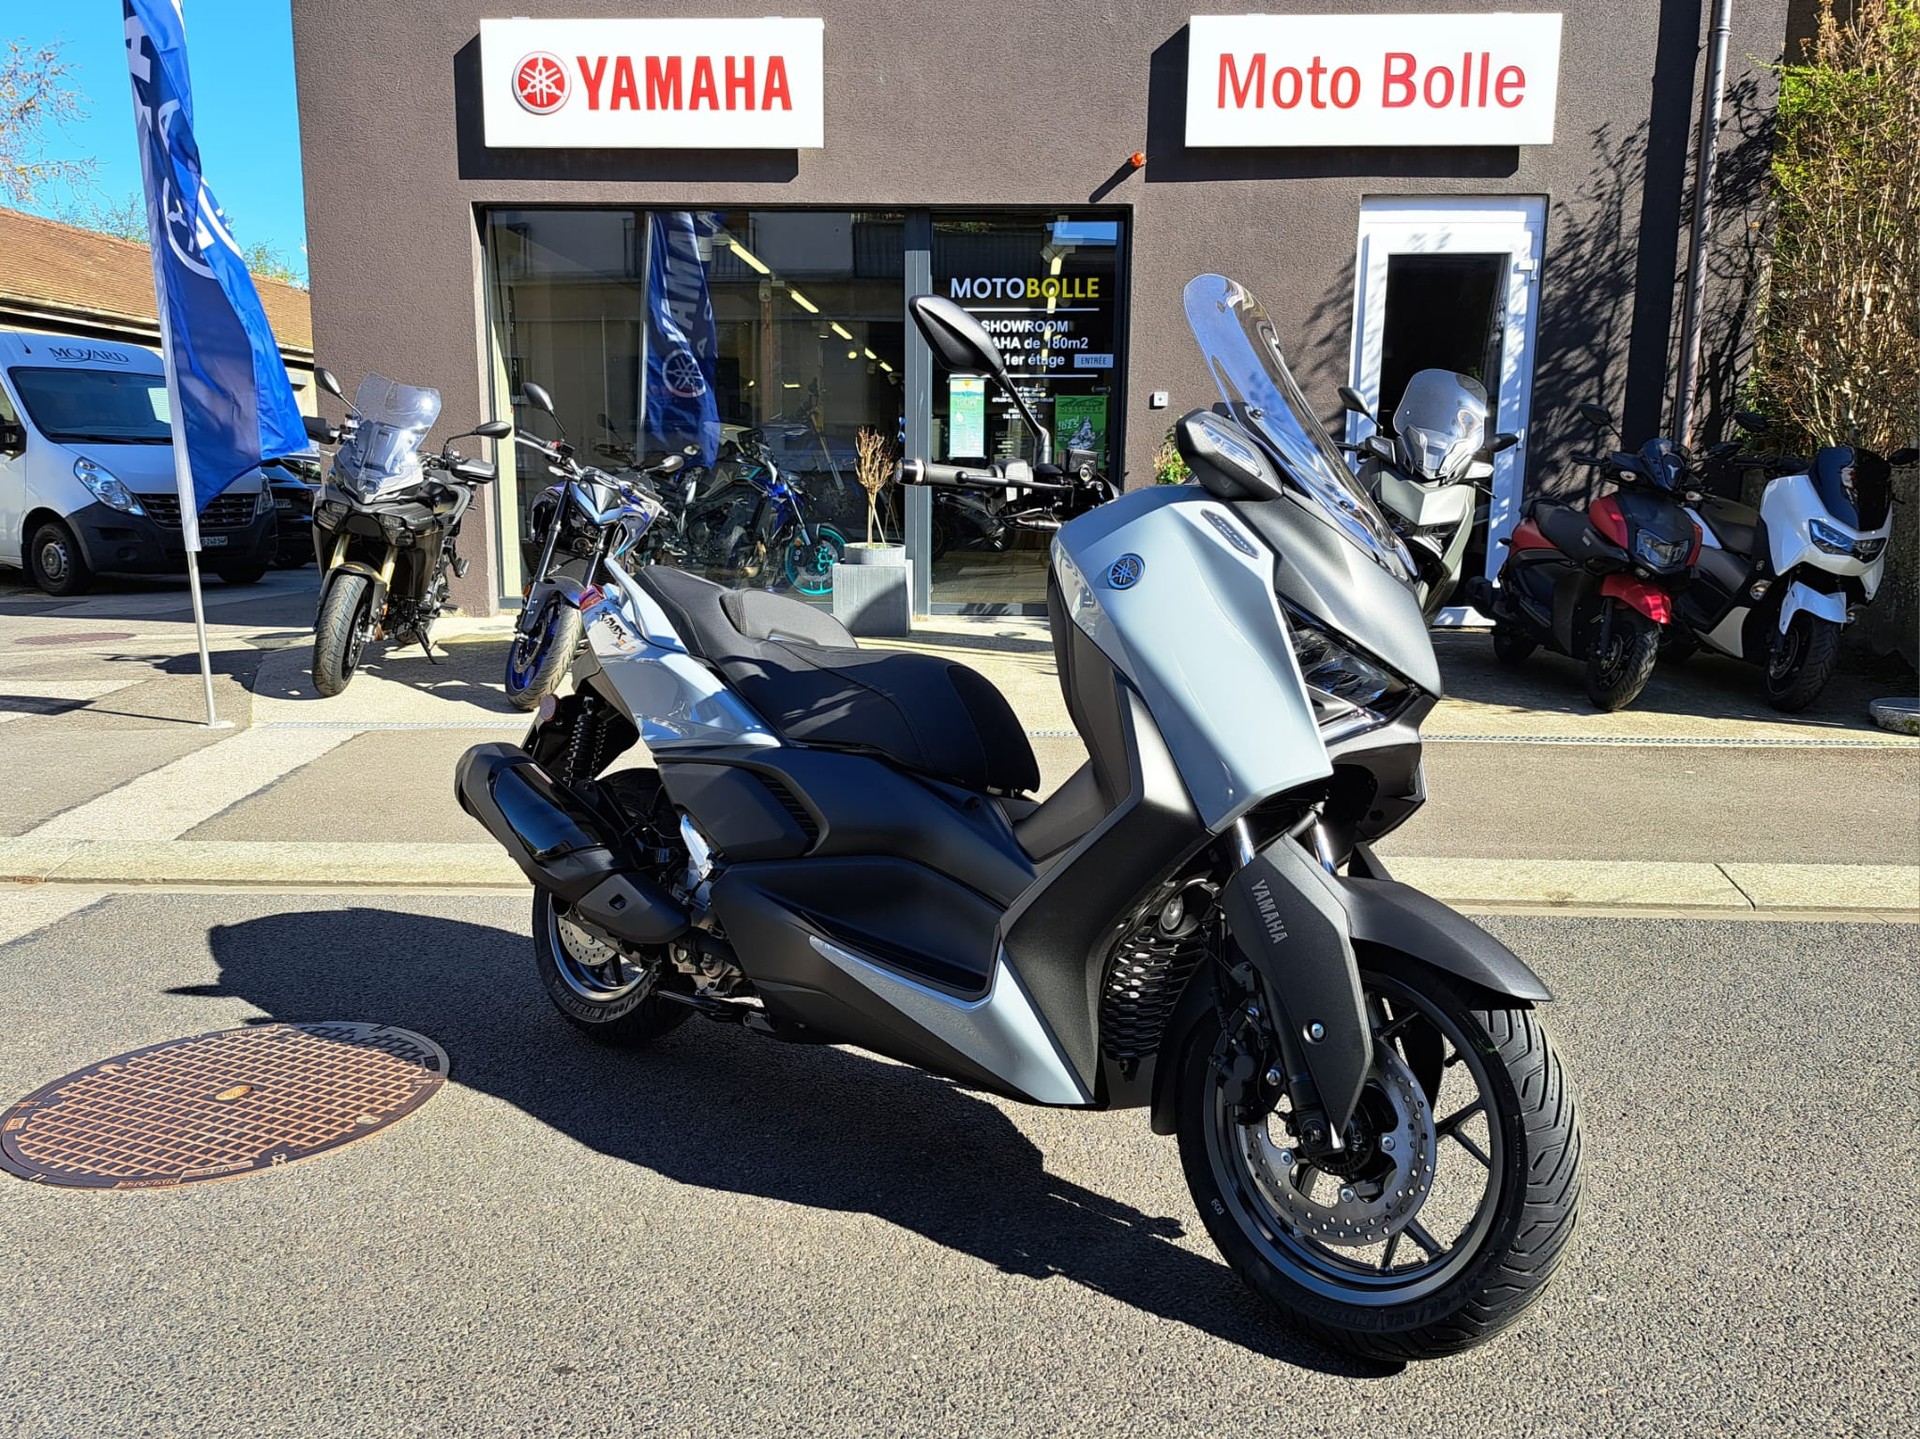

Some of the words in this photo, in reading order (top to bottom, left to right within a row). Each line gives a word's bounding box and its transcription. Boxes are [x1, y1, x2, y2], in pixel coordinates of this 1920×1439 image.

[576, 56, 793, 111] YAMAHA
[1217, 53, 1361, 109] Moto
[1382, 52, 1526, 108] Bolle
[950, 277, 1100, 299] MOTOBOLLE
[980, 319, 1069, 334] SHOWROOM
[993, 336, 1022, 350] AHA
[1024, 336, 1041, 350] de
[1045, 336, 1089, 350] 180m2
[48, 347, 130, 365] MOYARD
[1004, 353, 1026, 366] 1er
[1028, 353, 1066, 368] étage
[1080, 355, 1108, 366] ENTRÉE
[1250, 878, 1289, 945] YAMAHA
